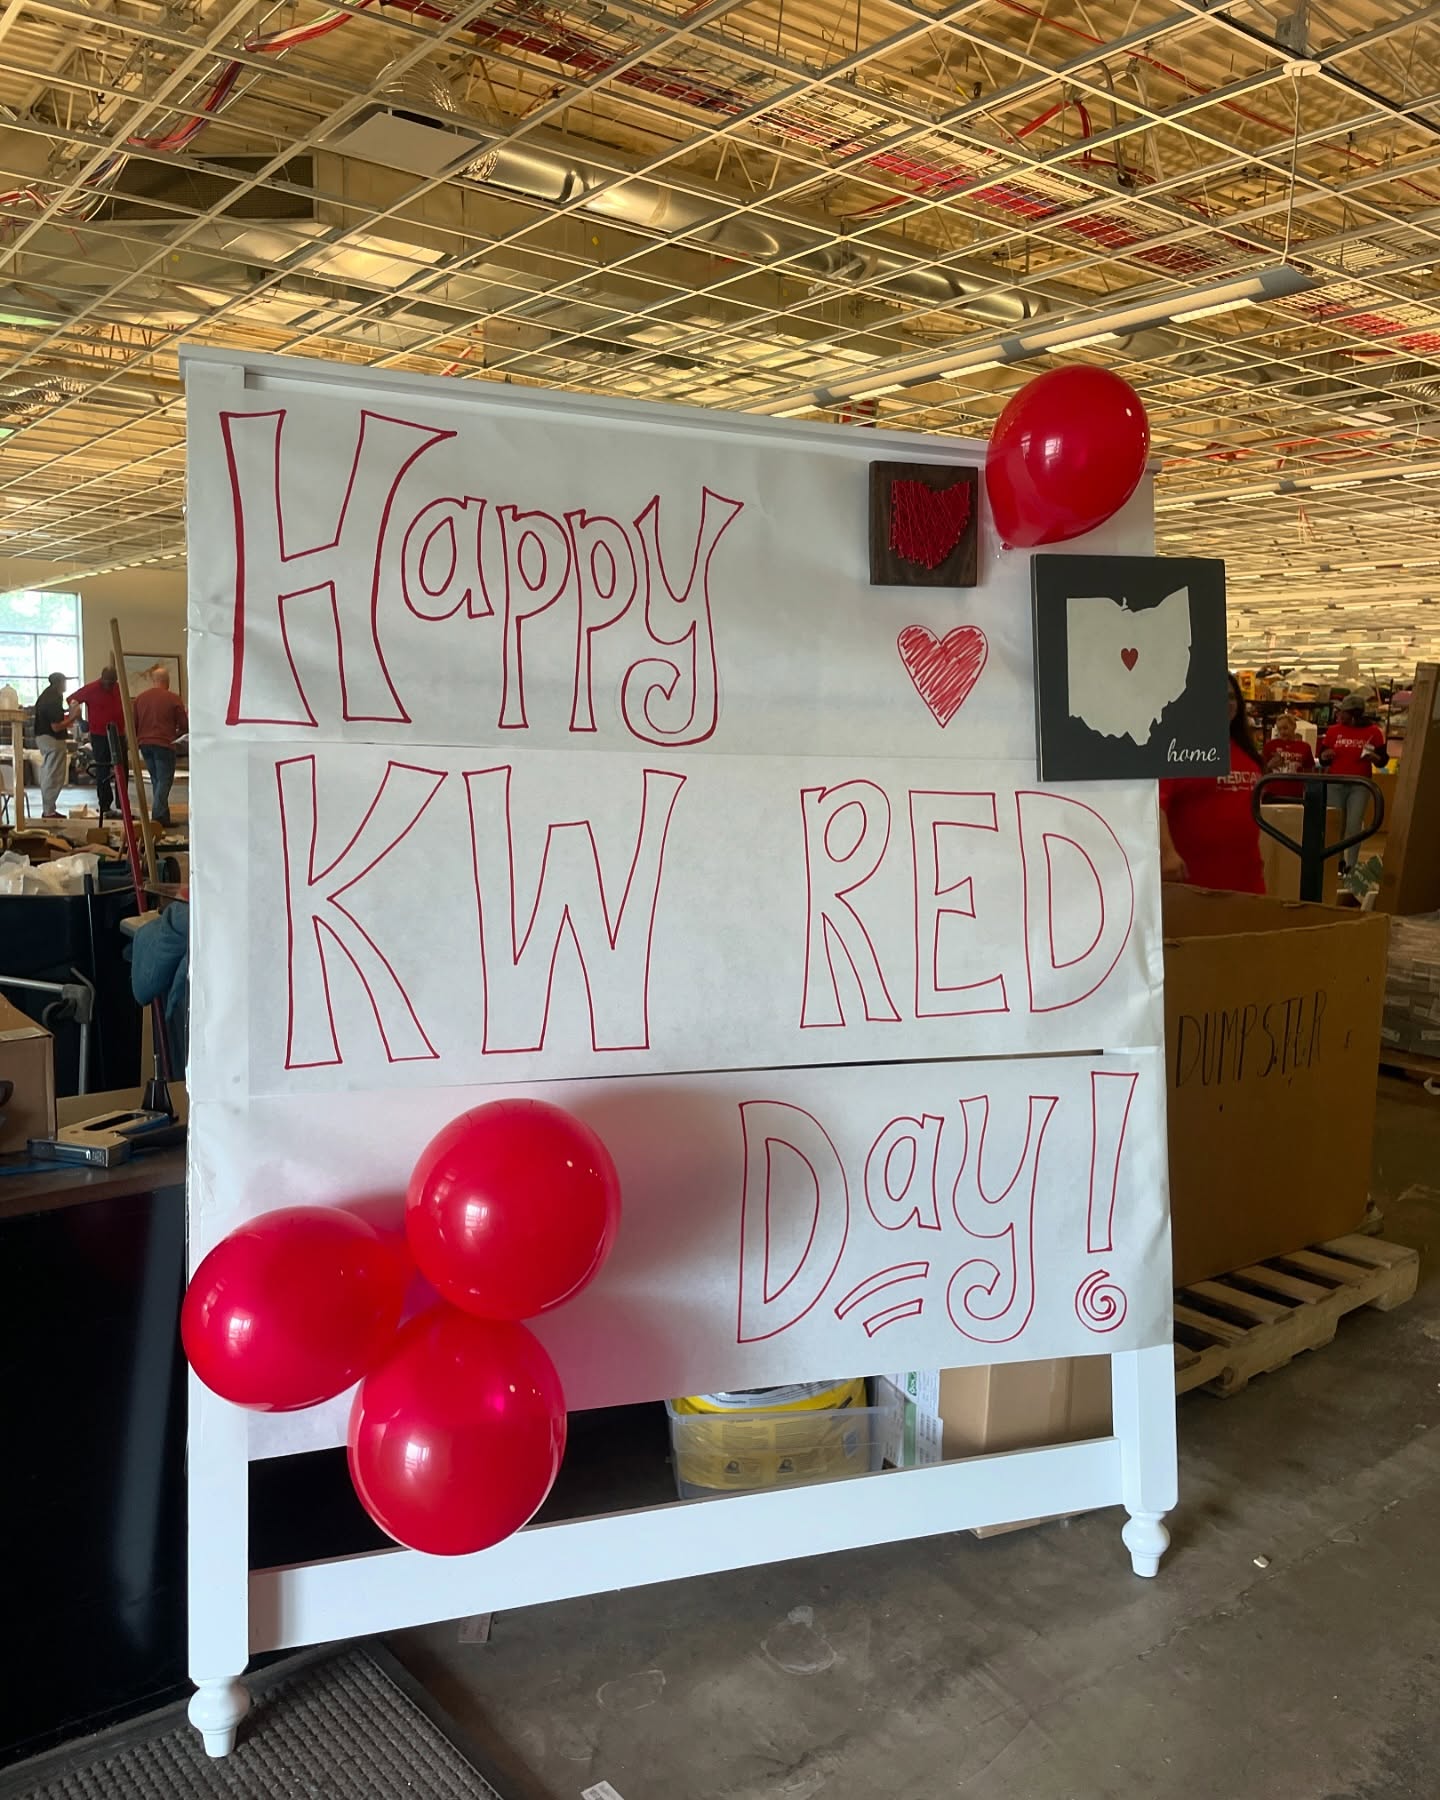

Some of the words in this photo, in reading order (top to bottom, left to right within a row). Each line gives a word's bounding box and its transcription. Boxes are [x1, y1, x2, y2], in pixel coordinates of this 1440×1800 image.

[219, 409, 745, 747] Happy
[1167, 738, 1221, 762] home.
[274, 754, 687, 1071] KW
[800, 779, 1135, 1029] RED
[1175, 989, 1328, 1088] DUMPSTER
[737, 1071, 1140, 1344] Day!
